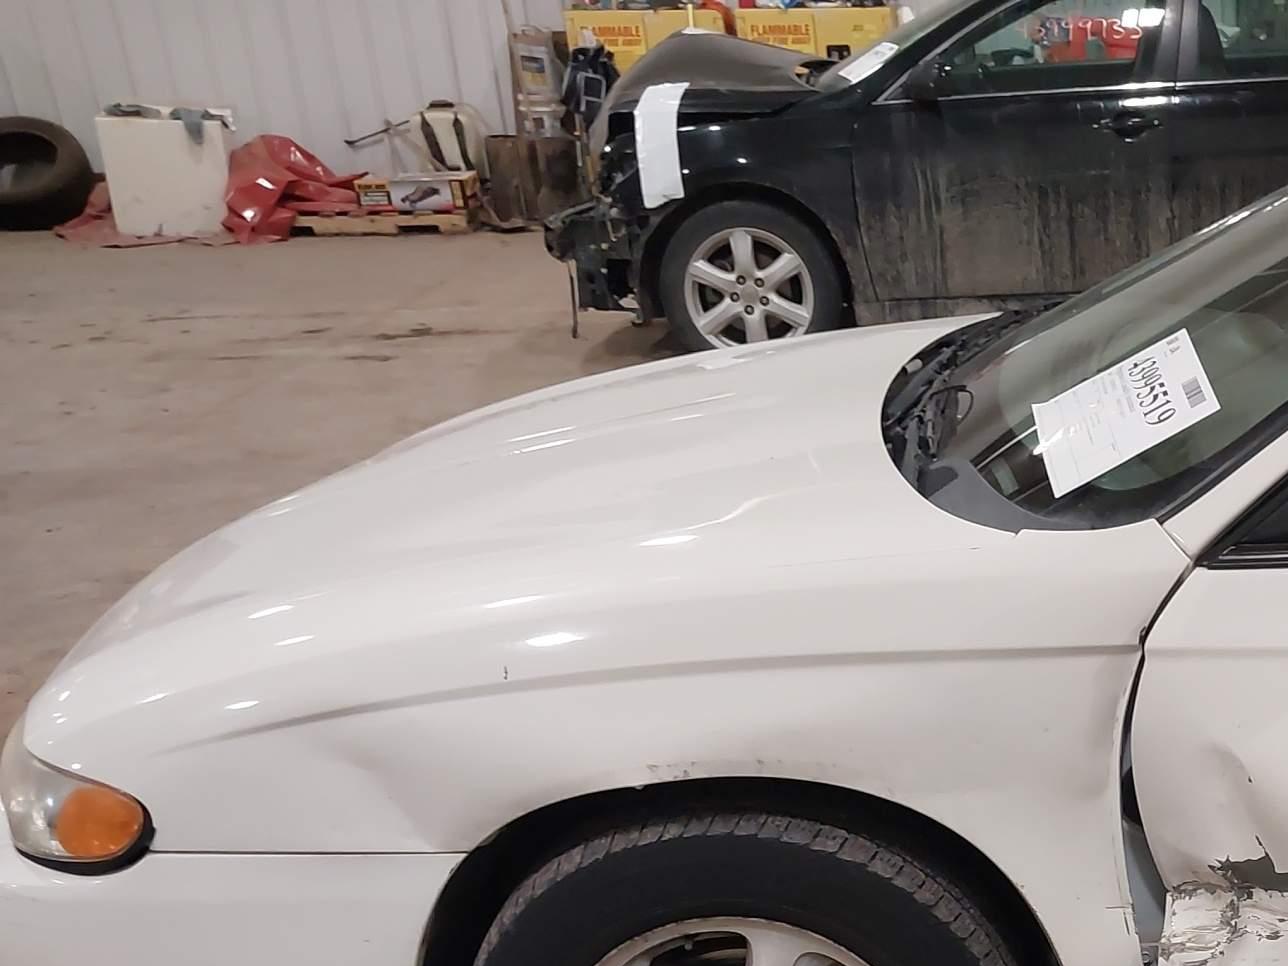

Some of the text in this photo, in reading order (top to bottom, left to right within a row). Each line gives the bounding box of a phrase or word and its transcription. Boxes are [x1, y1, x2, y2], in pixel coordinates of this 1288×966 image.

[580, 25, 641, 38] AMMABLE
[750, 24, 810, 37] FLAMMABLE
[1127, 356, 1177, 427] 43995519
